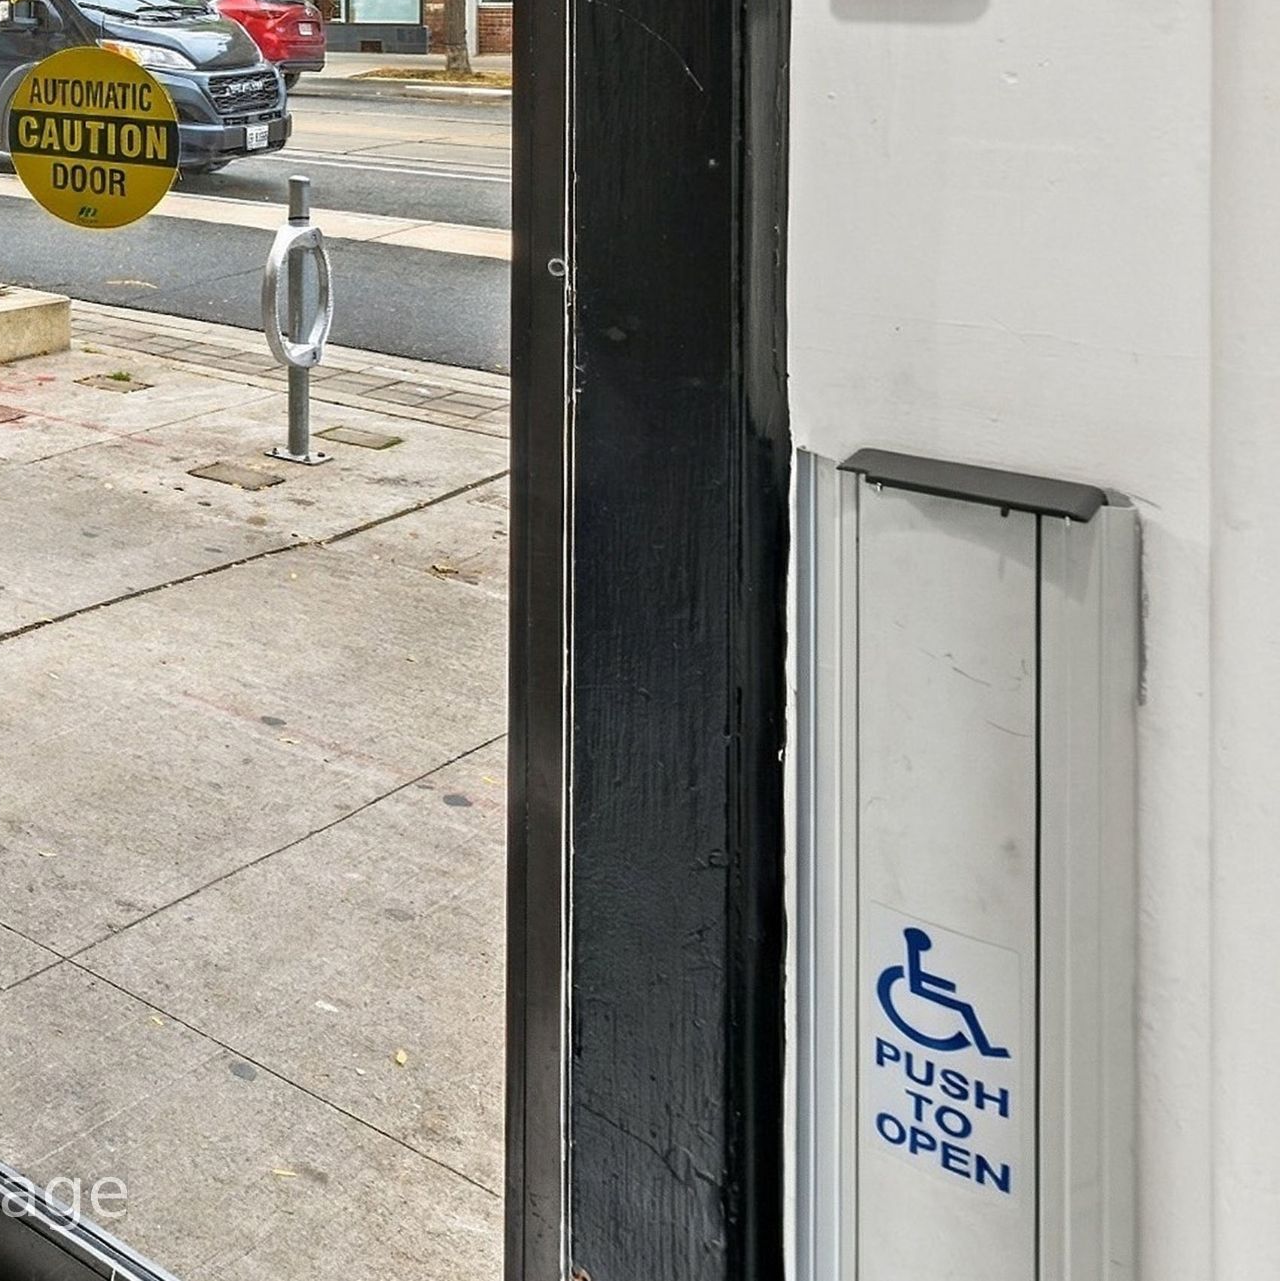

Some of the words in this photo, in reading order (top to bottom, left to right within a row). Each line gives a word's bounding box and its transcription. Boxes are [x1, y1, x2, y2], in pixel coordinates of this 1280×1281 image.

[30, 77, 152, 113] AUTOMATIC
[18, 115, 168, 160] CAUTION
[52, 162, 126, 197] DOOR
[875, 1036, 1010, 1119] PUSH
[905, 1088, 973, 1140] TO
[875, 1112, 1011, 1195] OPEN
